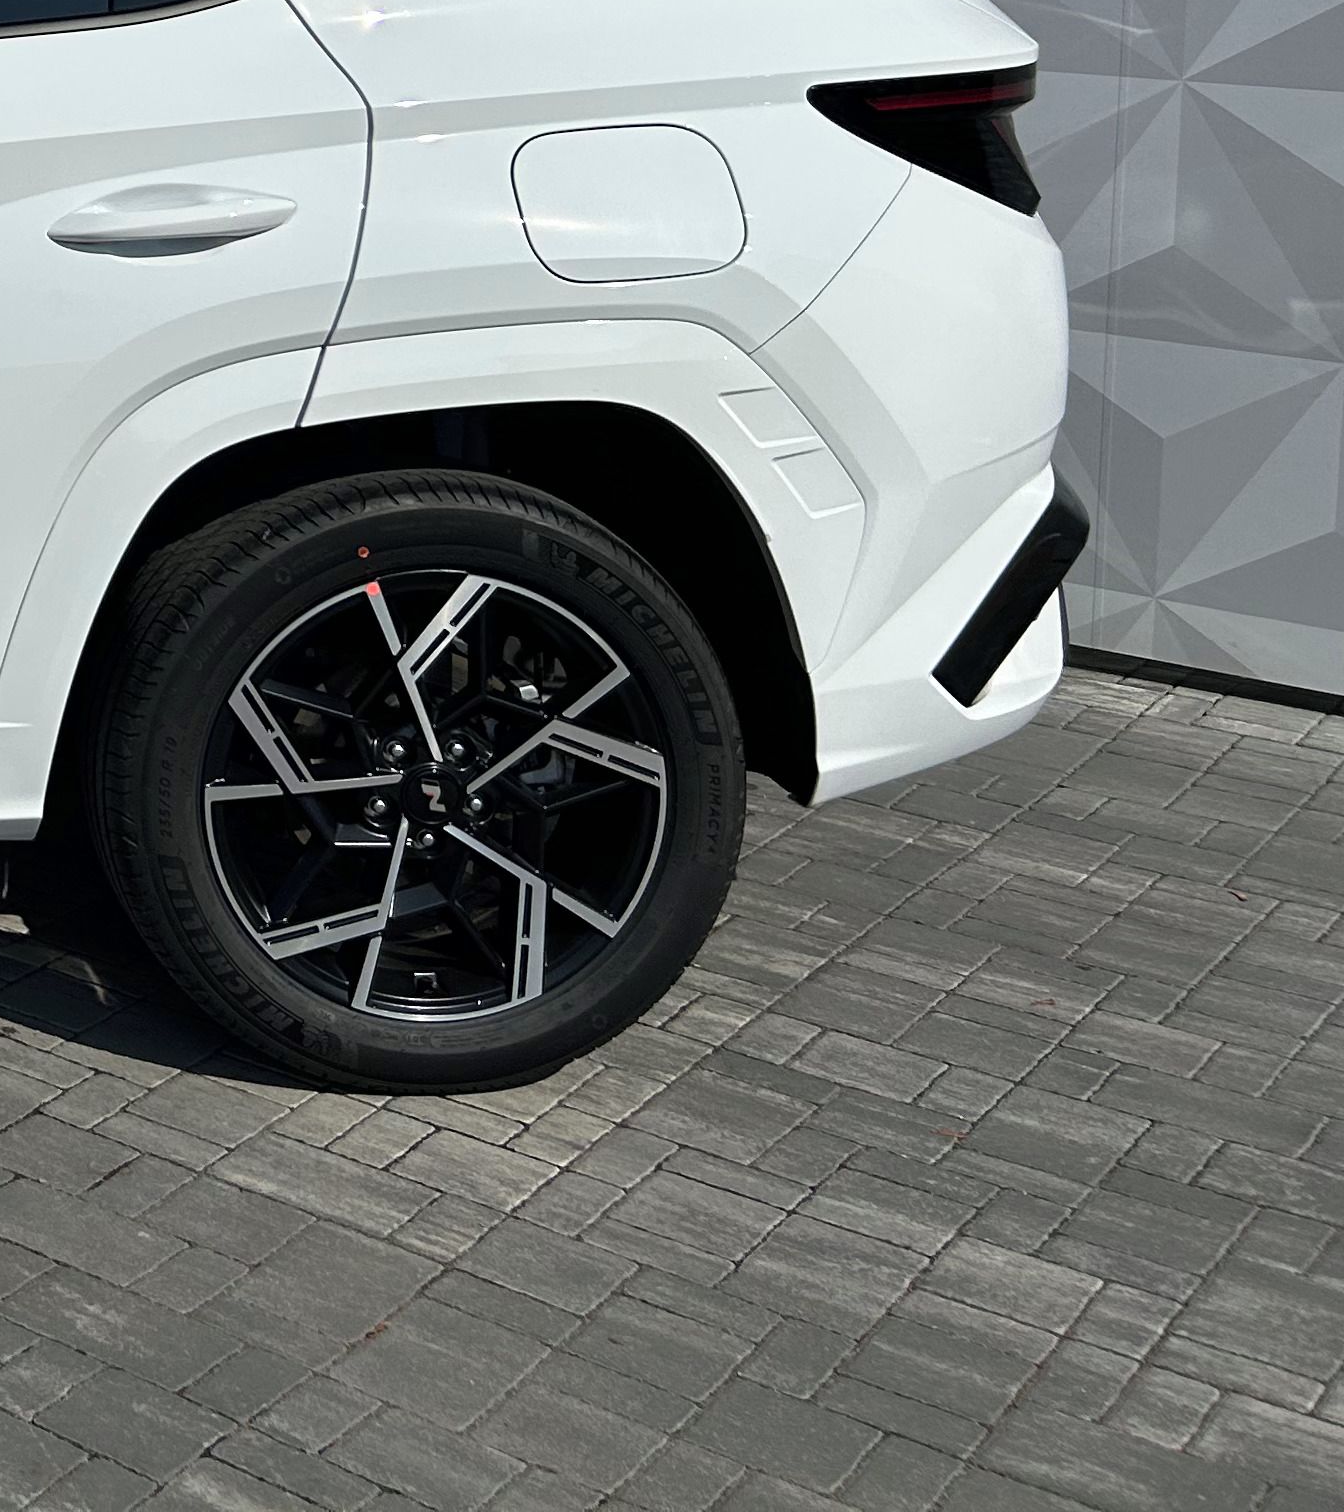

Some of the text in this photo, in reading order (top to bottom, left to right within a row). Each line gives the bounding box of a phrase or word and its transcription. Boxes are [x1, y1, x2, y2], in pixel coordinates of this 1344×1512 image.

[585, 566, 718, 734] MICHELIN
[706, 762, 722, 841] PRIMACY
[162, 866, 296, 1032] MICHELIN
